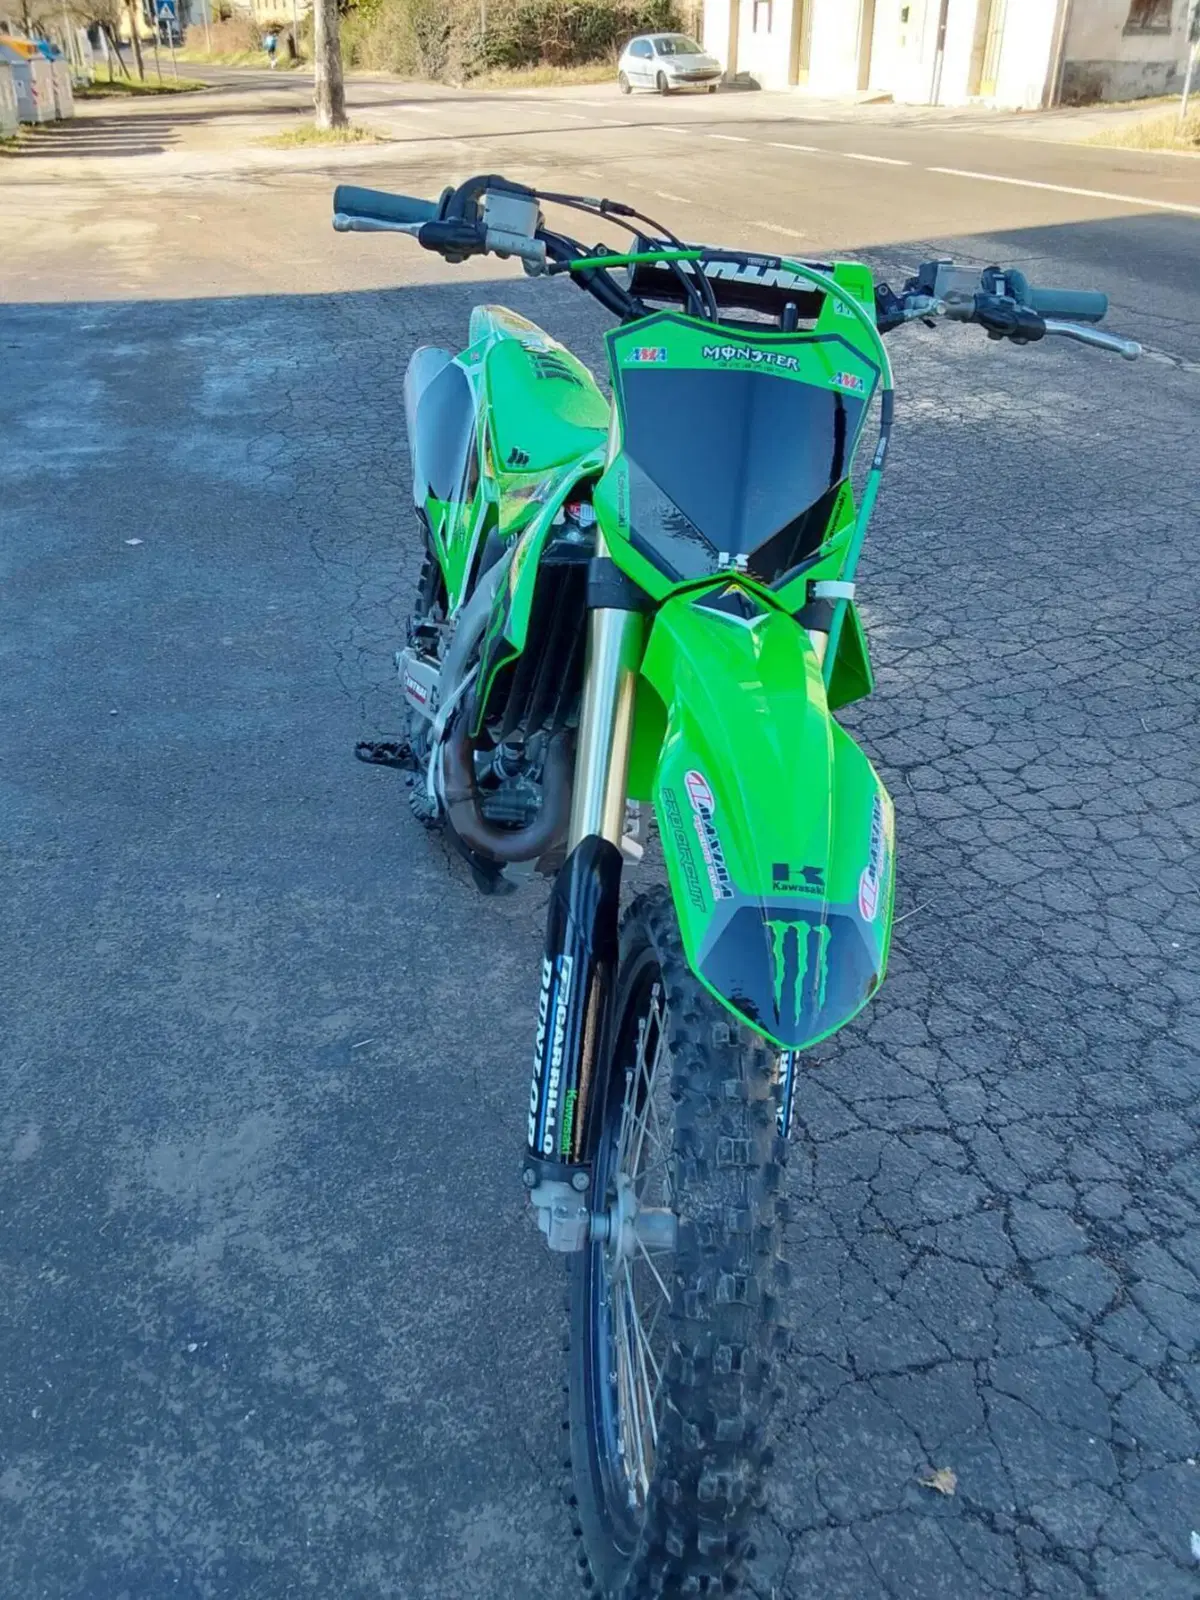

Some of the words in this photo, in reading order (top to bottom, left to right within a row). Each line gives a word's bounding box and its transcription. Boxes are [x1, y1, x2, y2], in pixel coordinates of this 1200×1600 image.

[703, 344, 801, 373] MONSTER
[675, 829, 706, 913] CIRCUIT
[772, 881, 825, 896] Kawasaki
[528, 957, 552, 1148] DUNLOP
[543, 1004, 567, 1155] CARRILLO
[561, 1089, 578, 1155] Kawasaki
